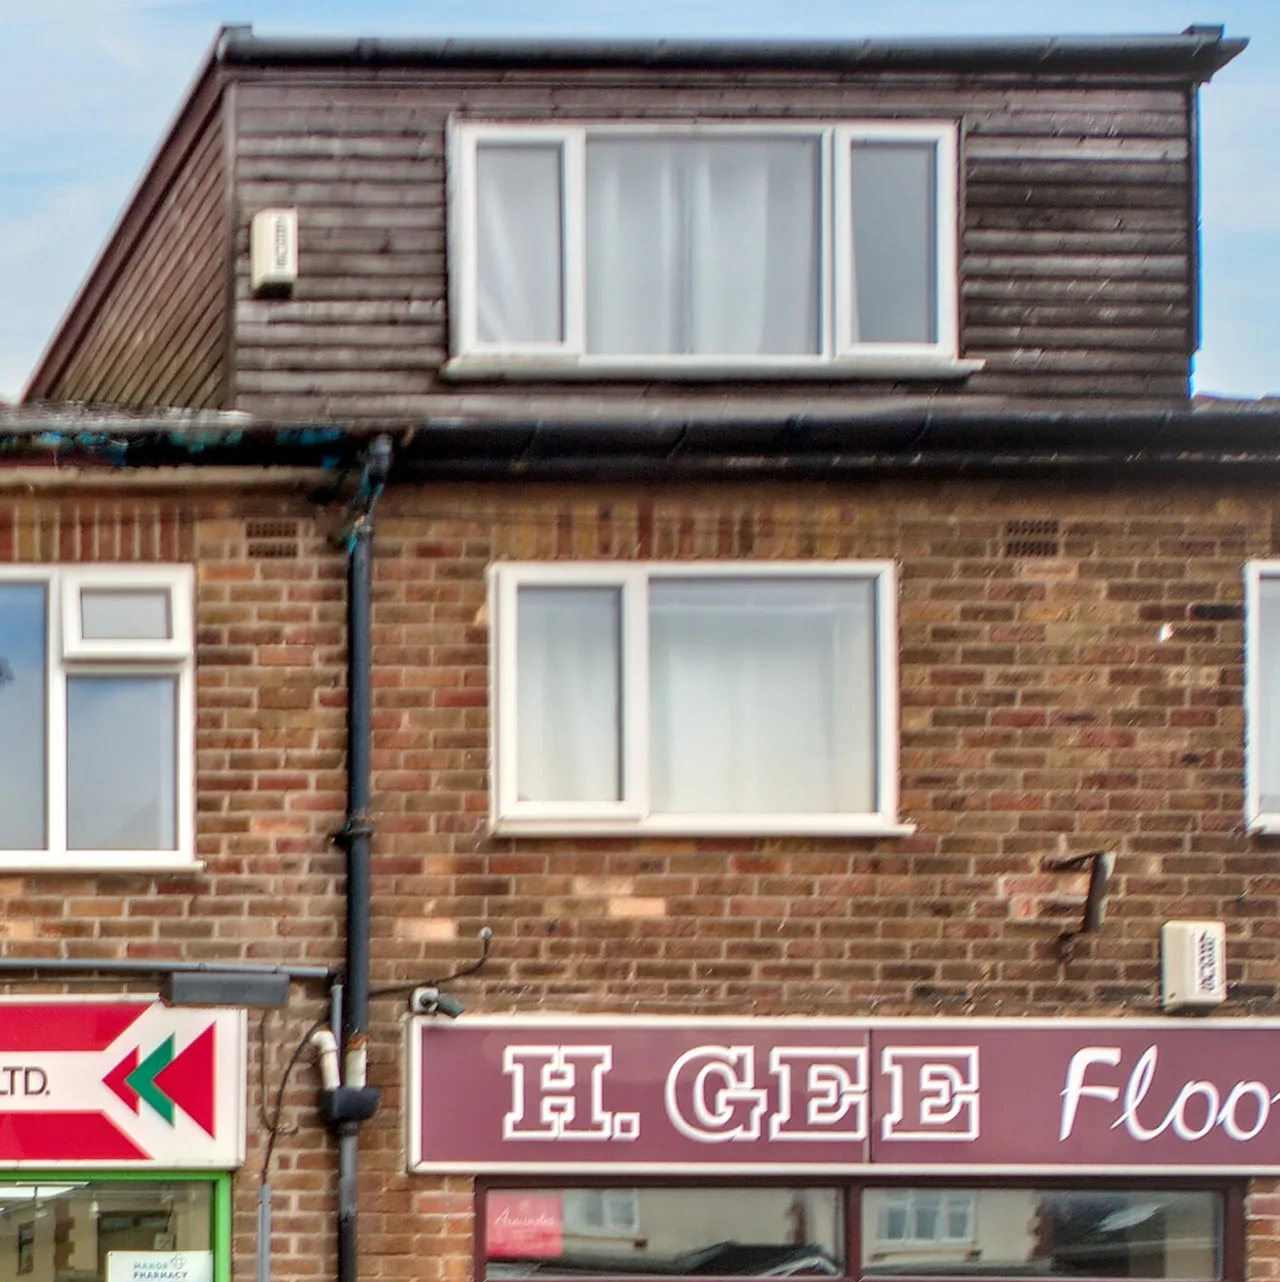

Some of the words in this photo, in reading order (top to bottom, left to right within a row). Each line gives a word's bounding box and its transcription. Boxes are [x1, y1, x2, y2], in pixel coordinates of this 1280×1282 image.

[502, 1044, 641, 1142] H.
[665, 1044, 981, 1143] GEE
[1058, 1044, 1280, 1143] Floo
[133, 1271, 188, 1279] PHARMACY
